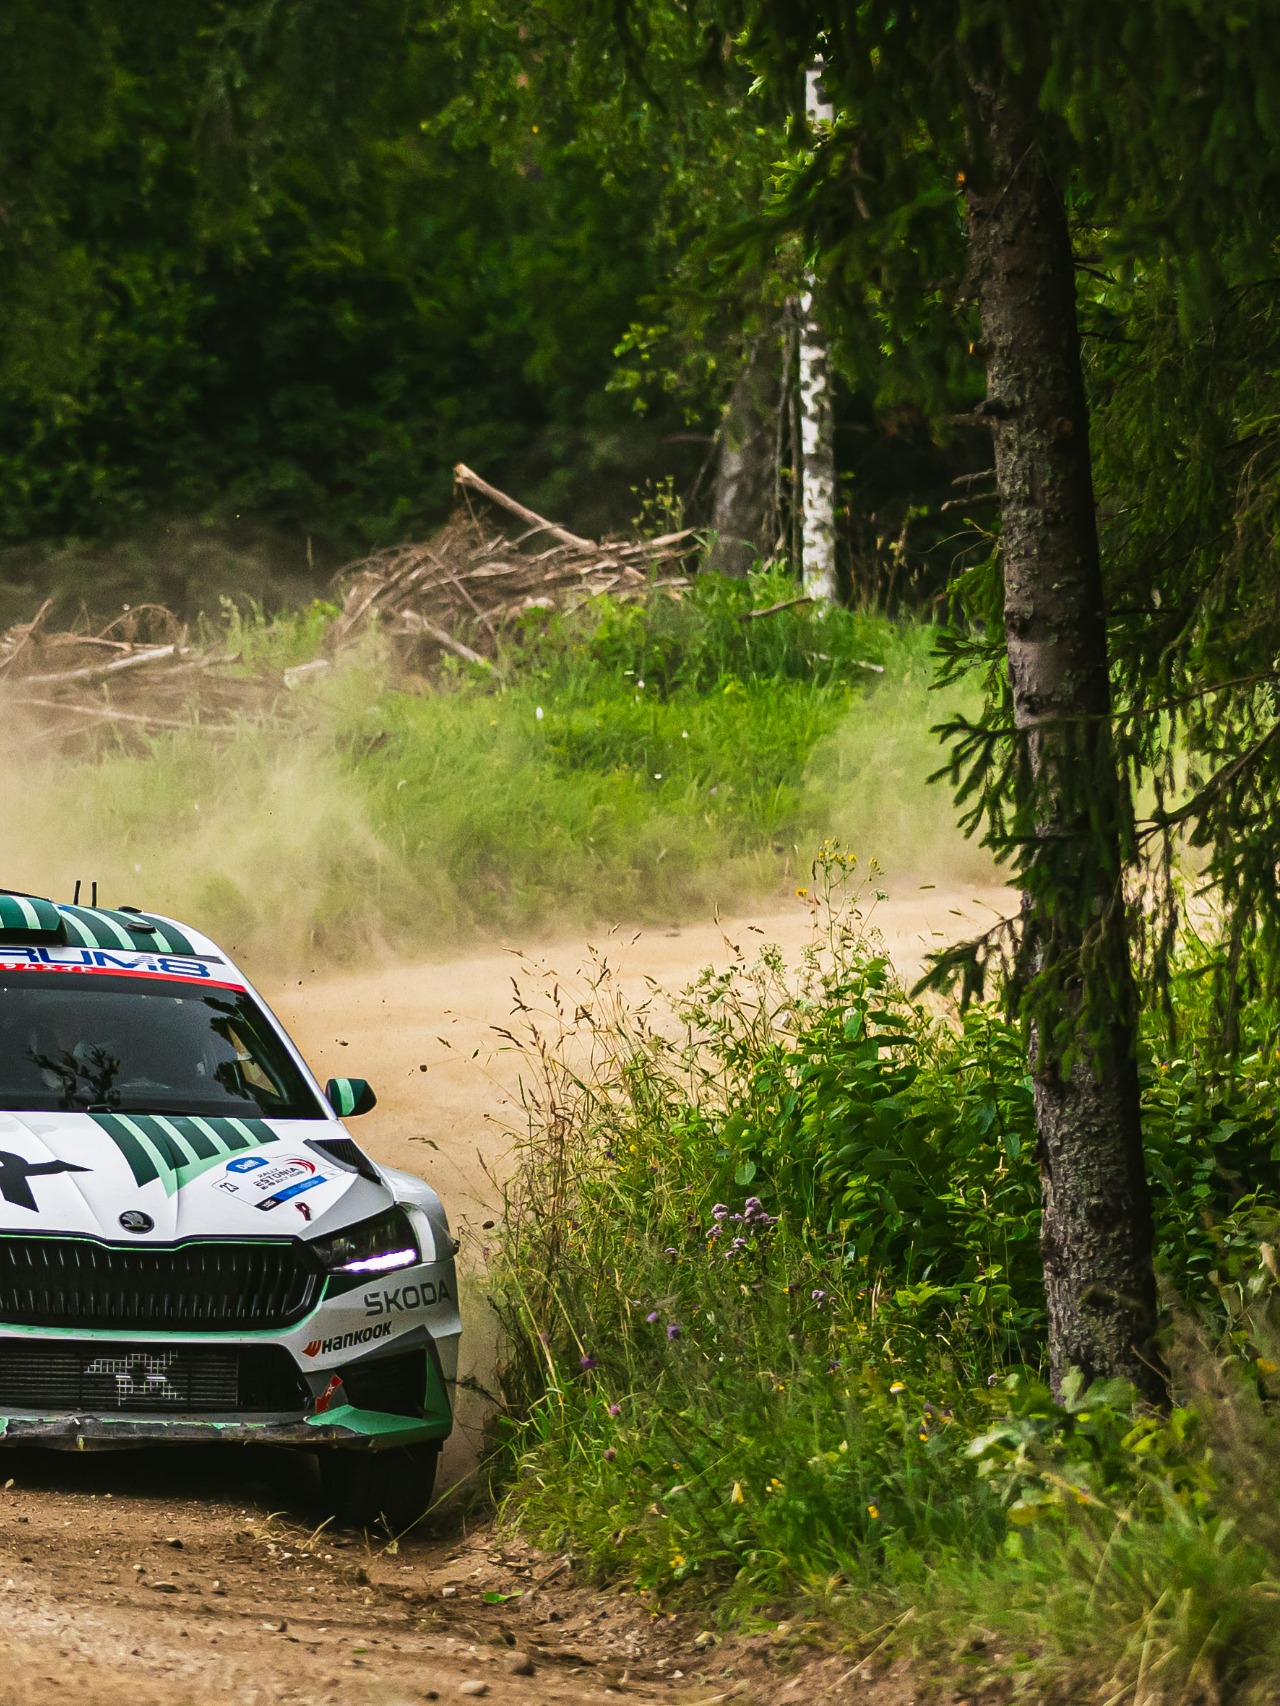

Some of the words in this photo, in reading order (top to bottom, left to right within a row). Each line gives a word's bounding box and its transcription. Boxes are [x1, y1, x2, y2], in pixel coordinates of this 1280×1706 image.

[253, 1167, 298, 1186] ESTONIA
[219, 1182, 239, 1192] 23
[364, 1279, 451, 1316] SKODA
